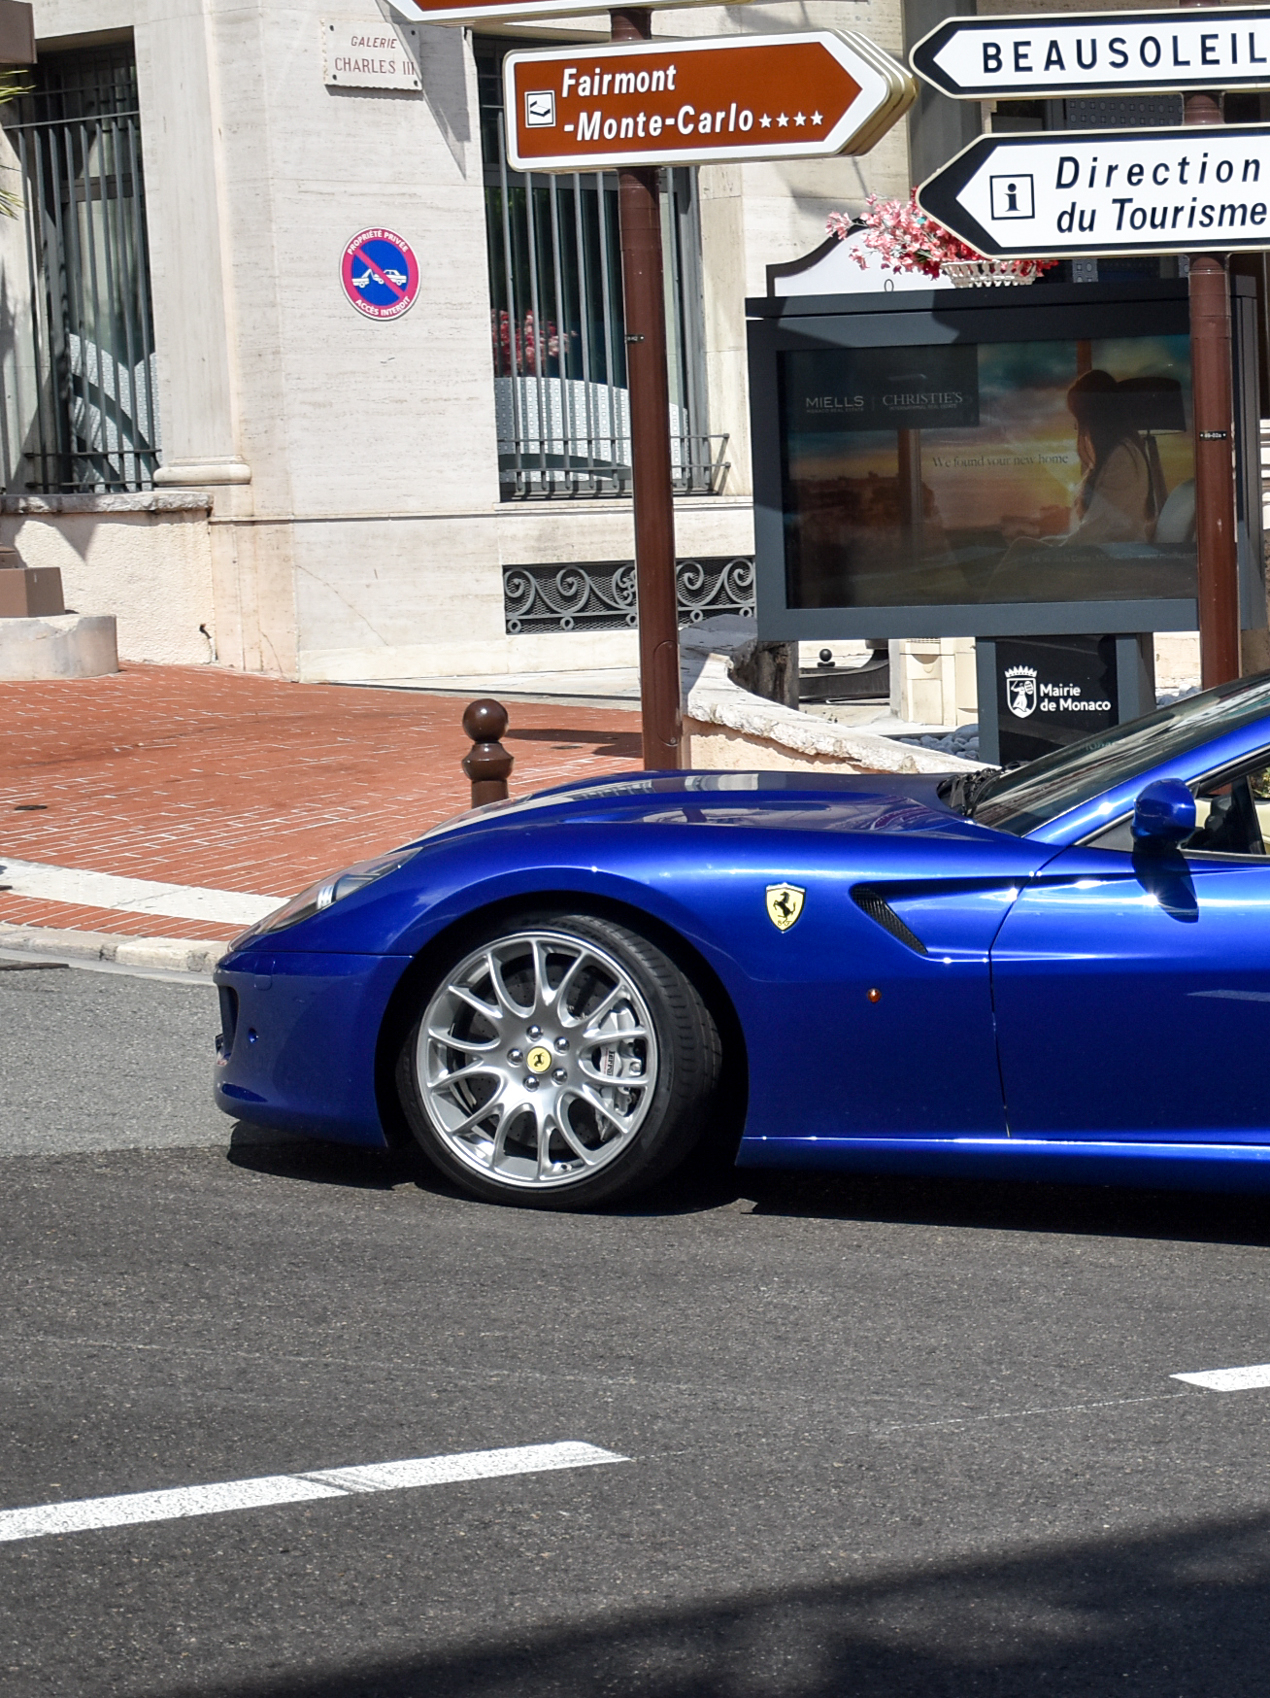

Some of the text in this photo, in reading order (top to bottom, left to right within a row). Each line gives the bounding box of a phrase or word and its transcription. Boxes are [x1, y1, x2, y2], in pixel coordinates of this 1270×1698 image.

[350, 35, 398, 49] GALERIE
[982, 32, 1268, 74] BEAUSOLEIL
[334, 57, 416, 75] CHARLES III
[561, 64, 677, 98] Fairmont
[1055, 152, 1261, 190] Direction
[1056, 197, 1268, 234] du Tourisme
[346, 230, 410, 256] PROPRIÉTÉ PRIVÉE
[355, 295, 411, 317] ACCÈS INTERDIT
[805, 392, 963, 408] MIELLS CHRISTIE'S
[932, 454, 1069, 468] We found your new home
[1040, 683, 1081, 696] Mairie
[1039, 698, 1111, 712] de Monaco
